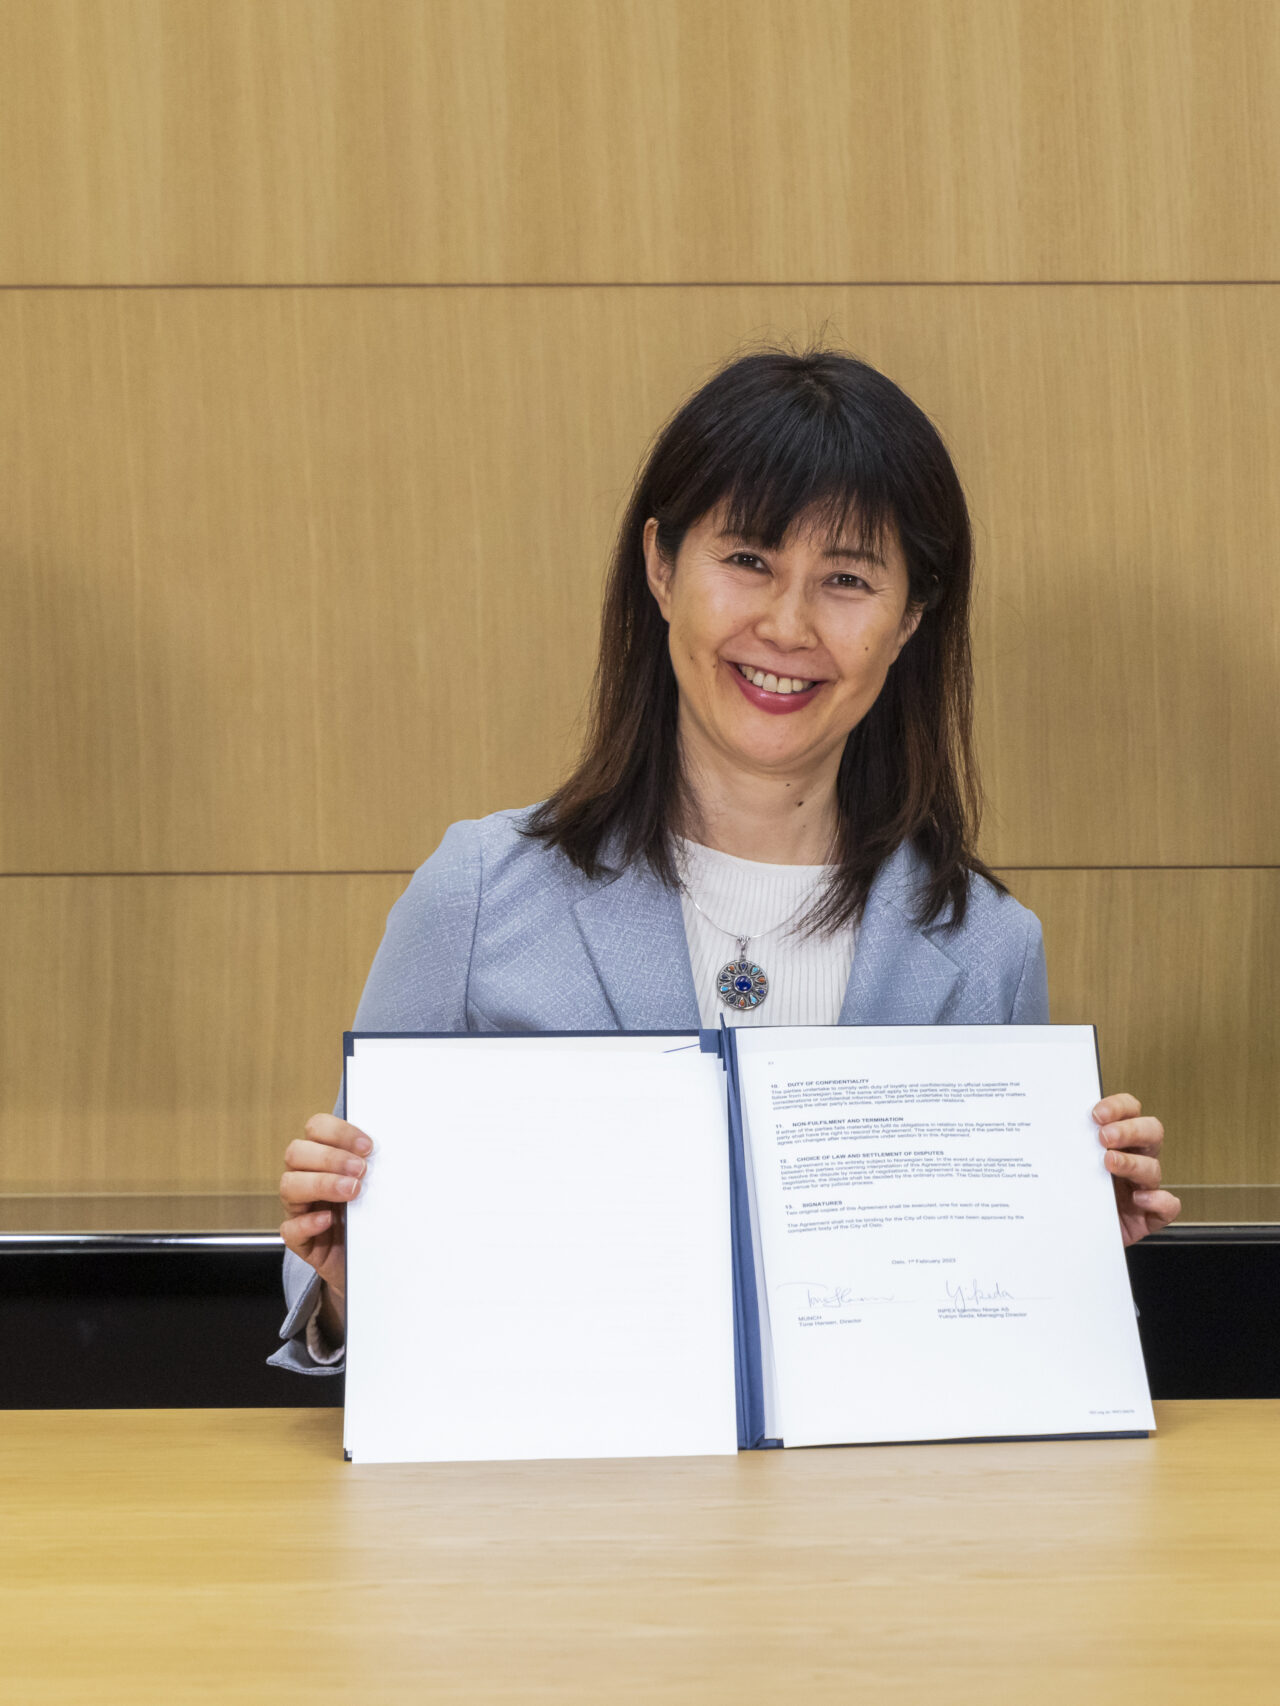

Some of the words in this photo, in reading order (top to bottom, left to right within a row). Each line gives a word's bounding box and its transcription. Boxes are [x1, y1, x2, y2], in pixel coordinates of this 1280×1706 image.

[815, 1078, 869, 1086] CONFIDENTIALITY
[792, 1118, 846, 1127] NON-FULFILMENT
[802, 1200, 842, 1208] SIGNATURES
